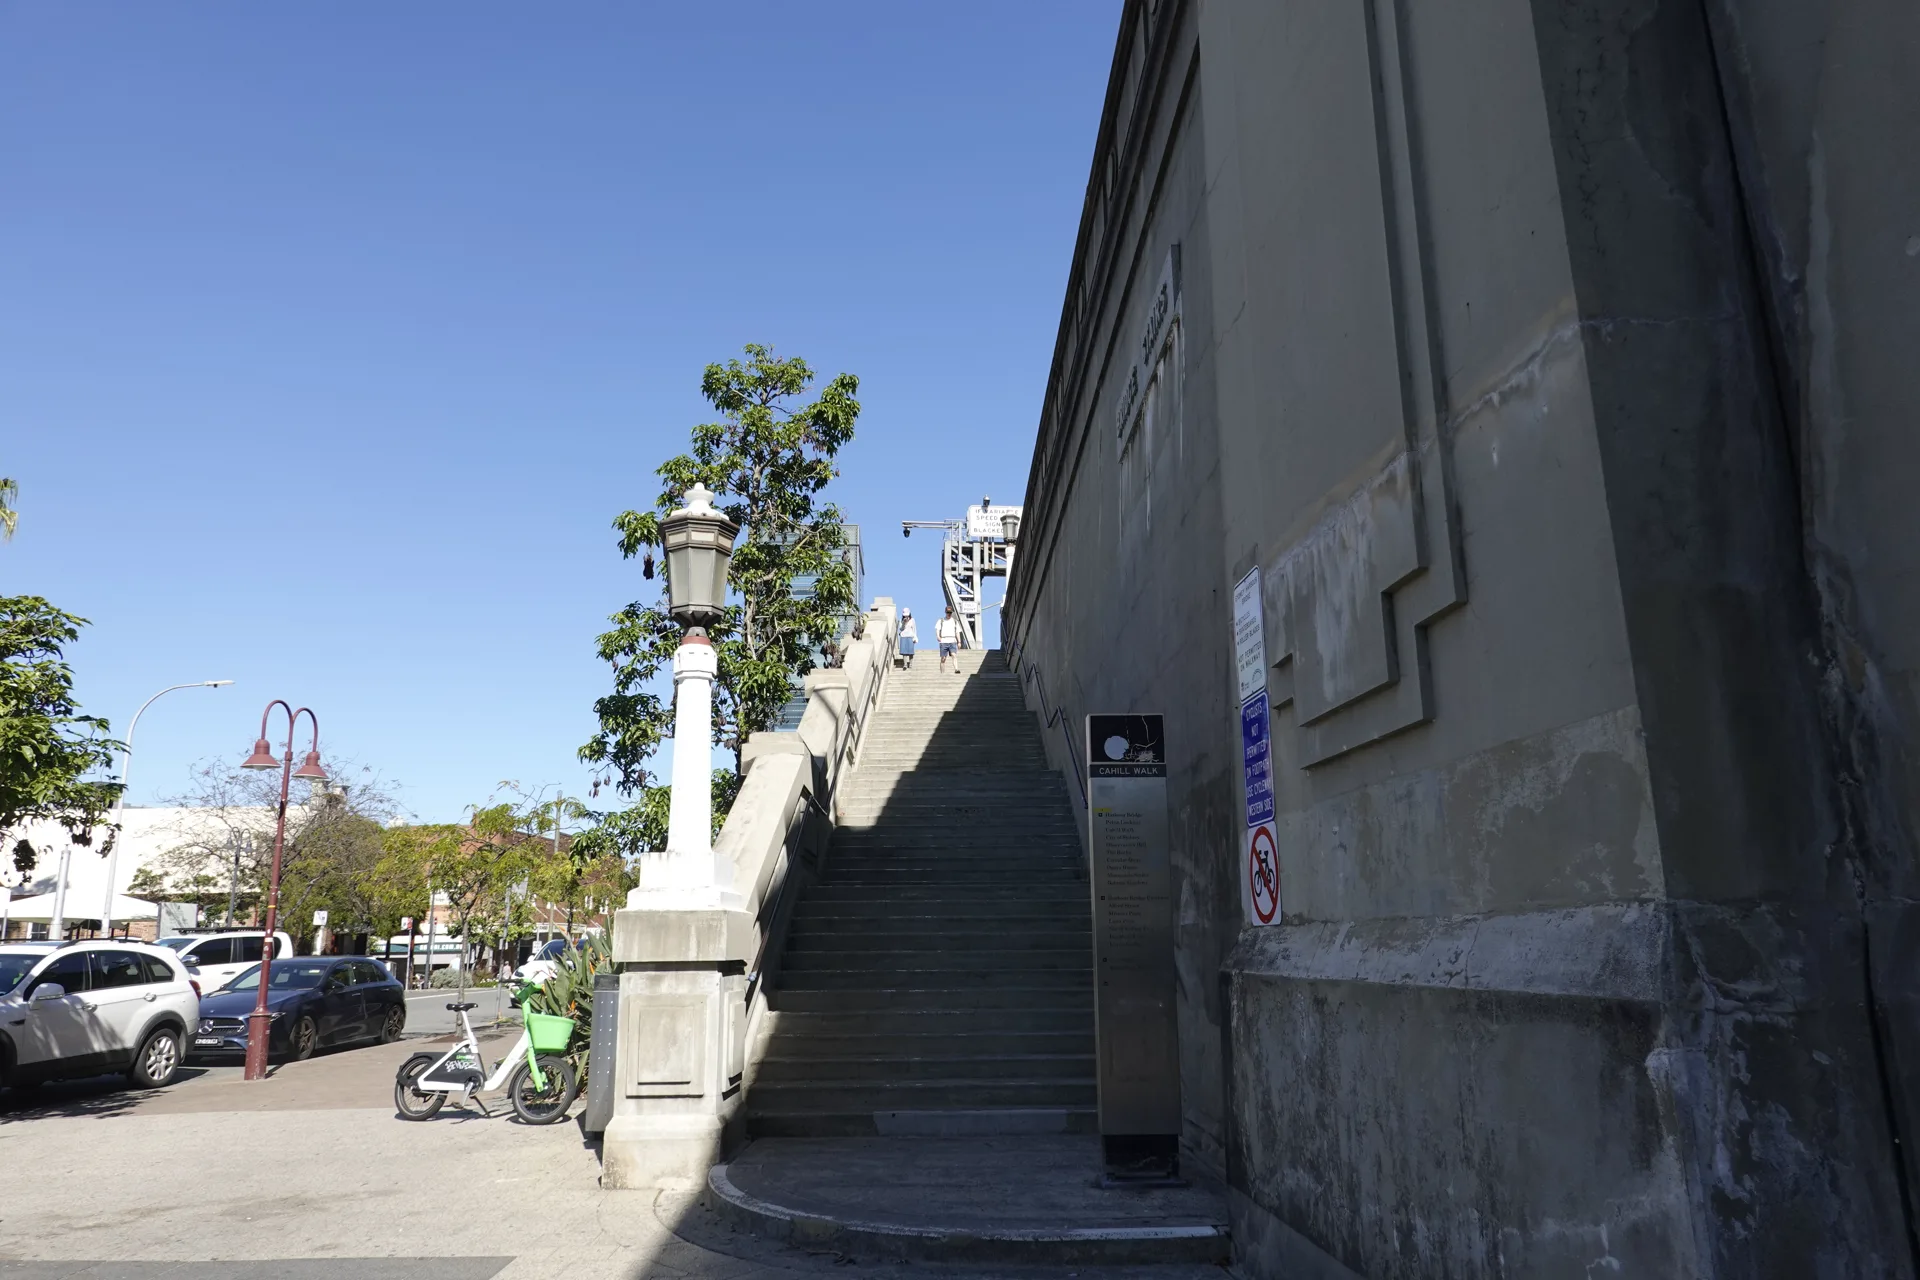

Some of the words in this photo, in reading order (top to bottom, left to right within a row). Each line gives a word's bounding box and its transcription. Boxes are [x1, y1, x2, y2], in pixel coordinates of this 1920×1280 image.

[1246, 702, 1262, 721] CYCLISTS
[1251, 723, 1259, 738] NOT
[1246, 739, 1268, 760] PERMITTED
[1099, 767, 1131, 775] CAHILL
[1133, 767, 1158, 775] WALK
[1252, 758, 1270, 777] FOOTPATH
[1253, 778, 1272, 796] CYCLEWAY
[1247, 801, 1264, 817] WESTERN
[1263, 797, 1272, 811] SIDE
